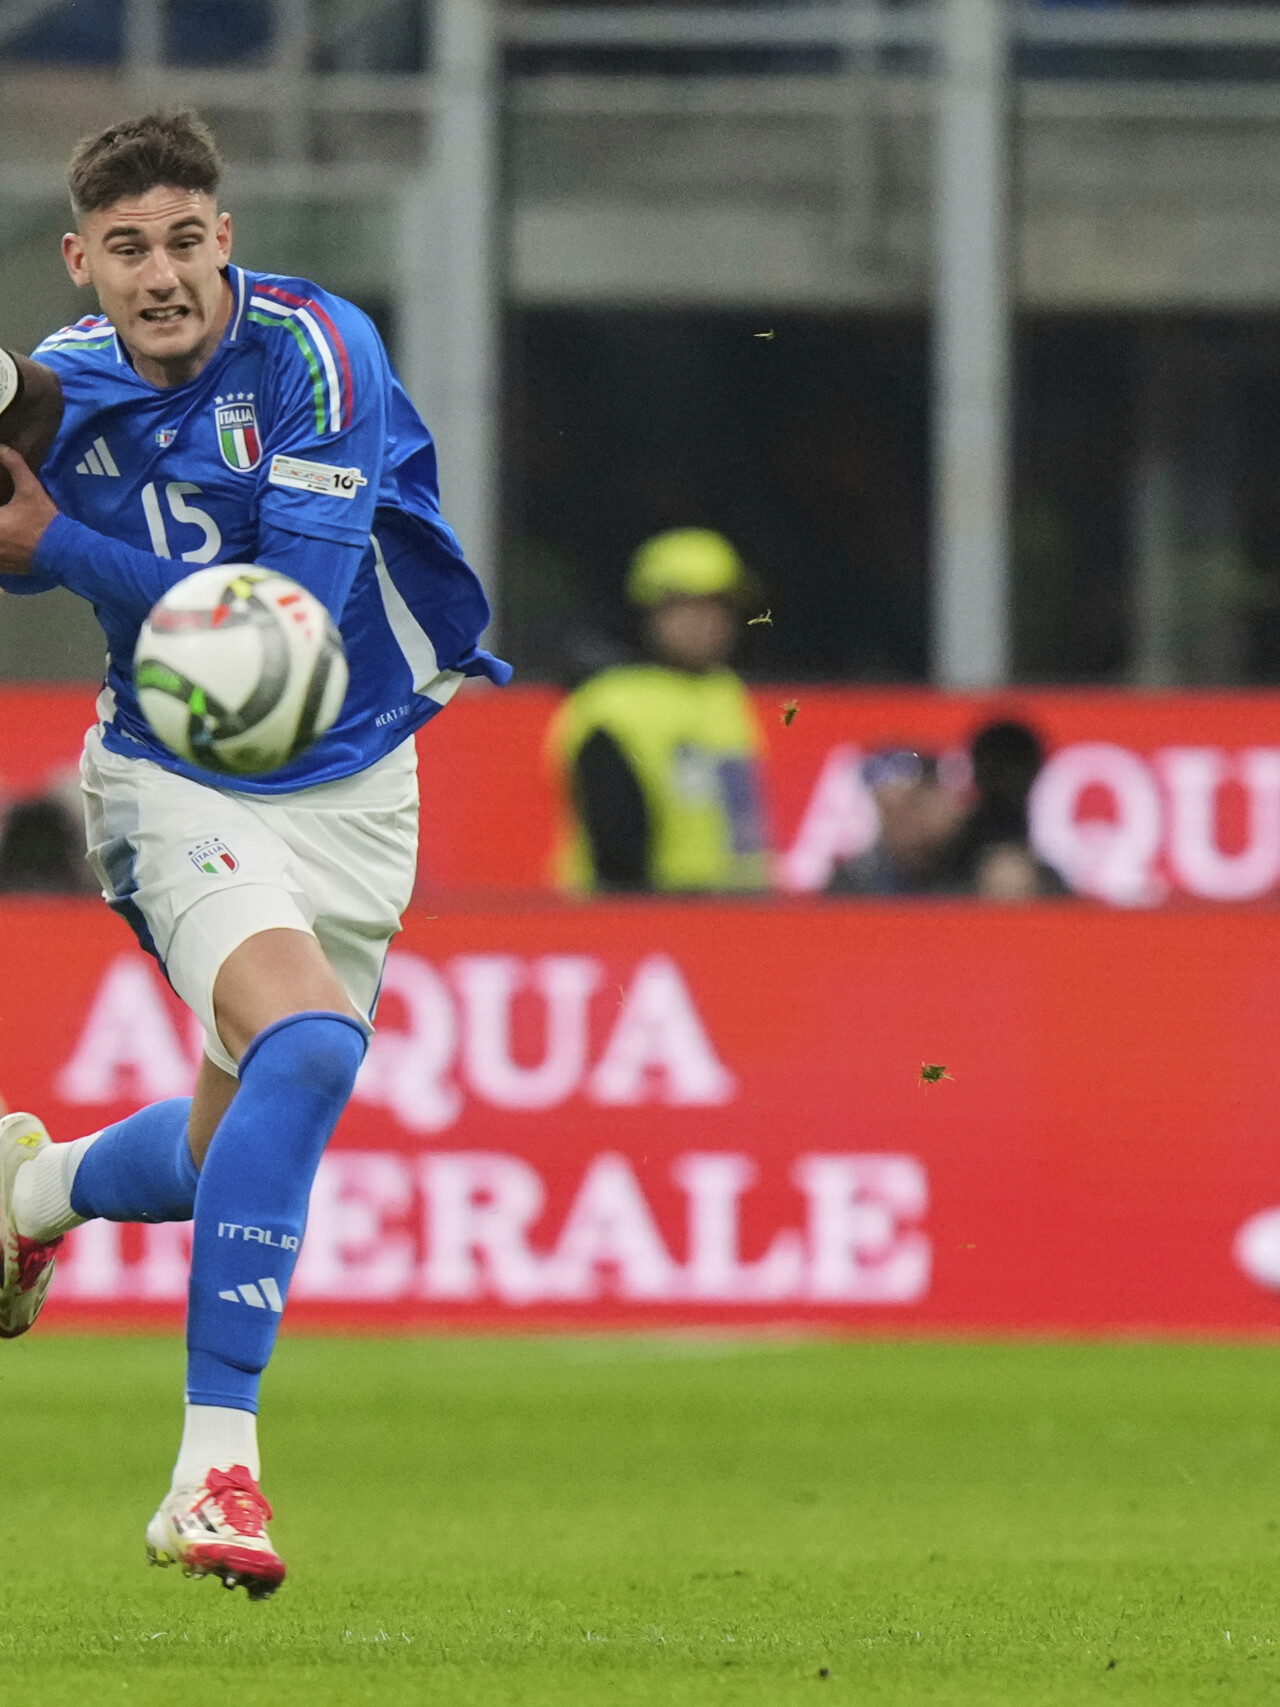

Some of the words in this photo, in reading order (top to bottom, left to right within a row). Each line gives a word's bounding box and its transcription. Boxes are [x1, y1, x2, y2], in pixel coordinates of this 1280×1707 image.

[220, 408, 253, 425] ITALIA
[141, 482, 222, 564] 15
[375, 709, 398, 728] HEAT
[194, 846, 223, 863] ITALIA
[218, 1222, 299, 1252] ITALIA
